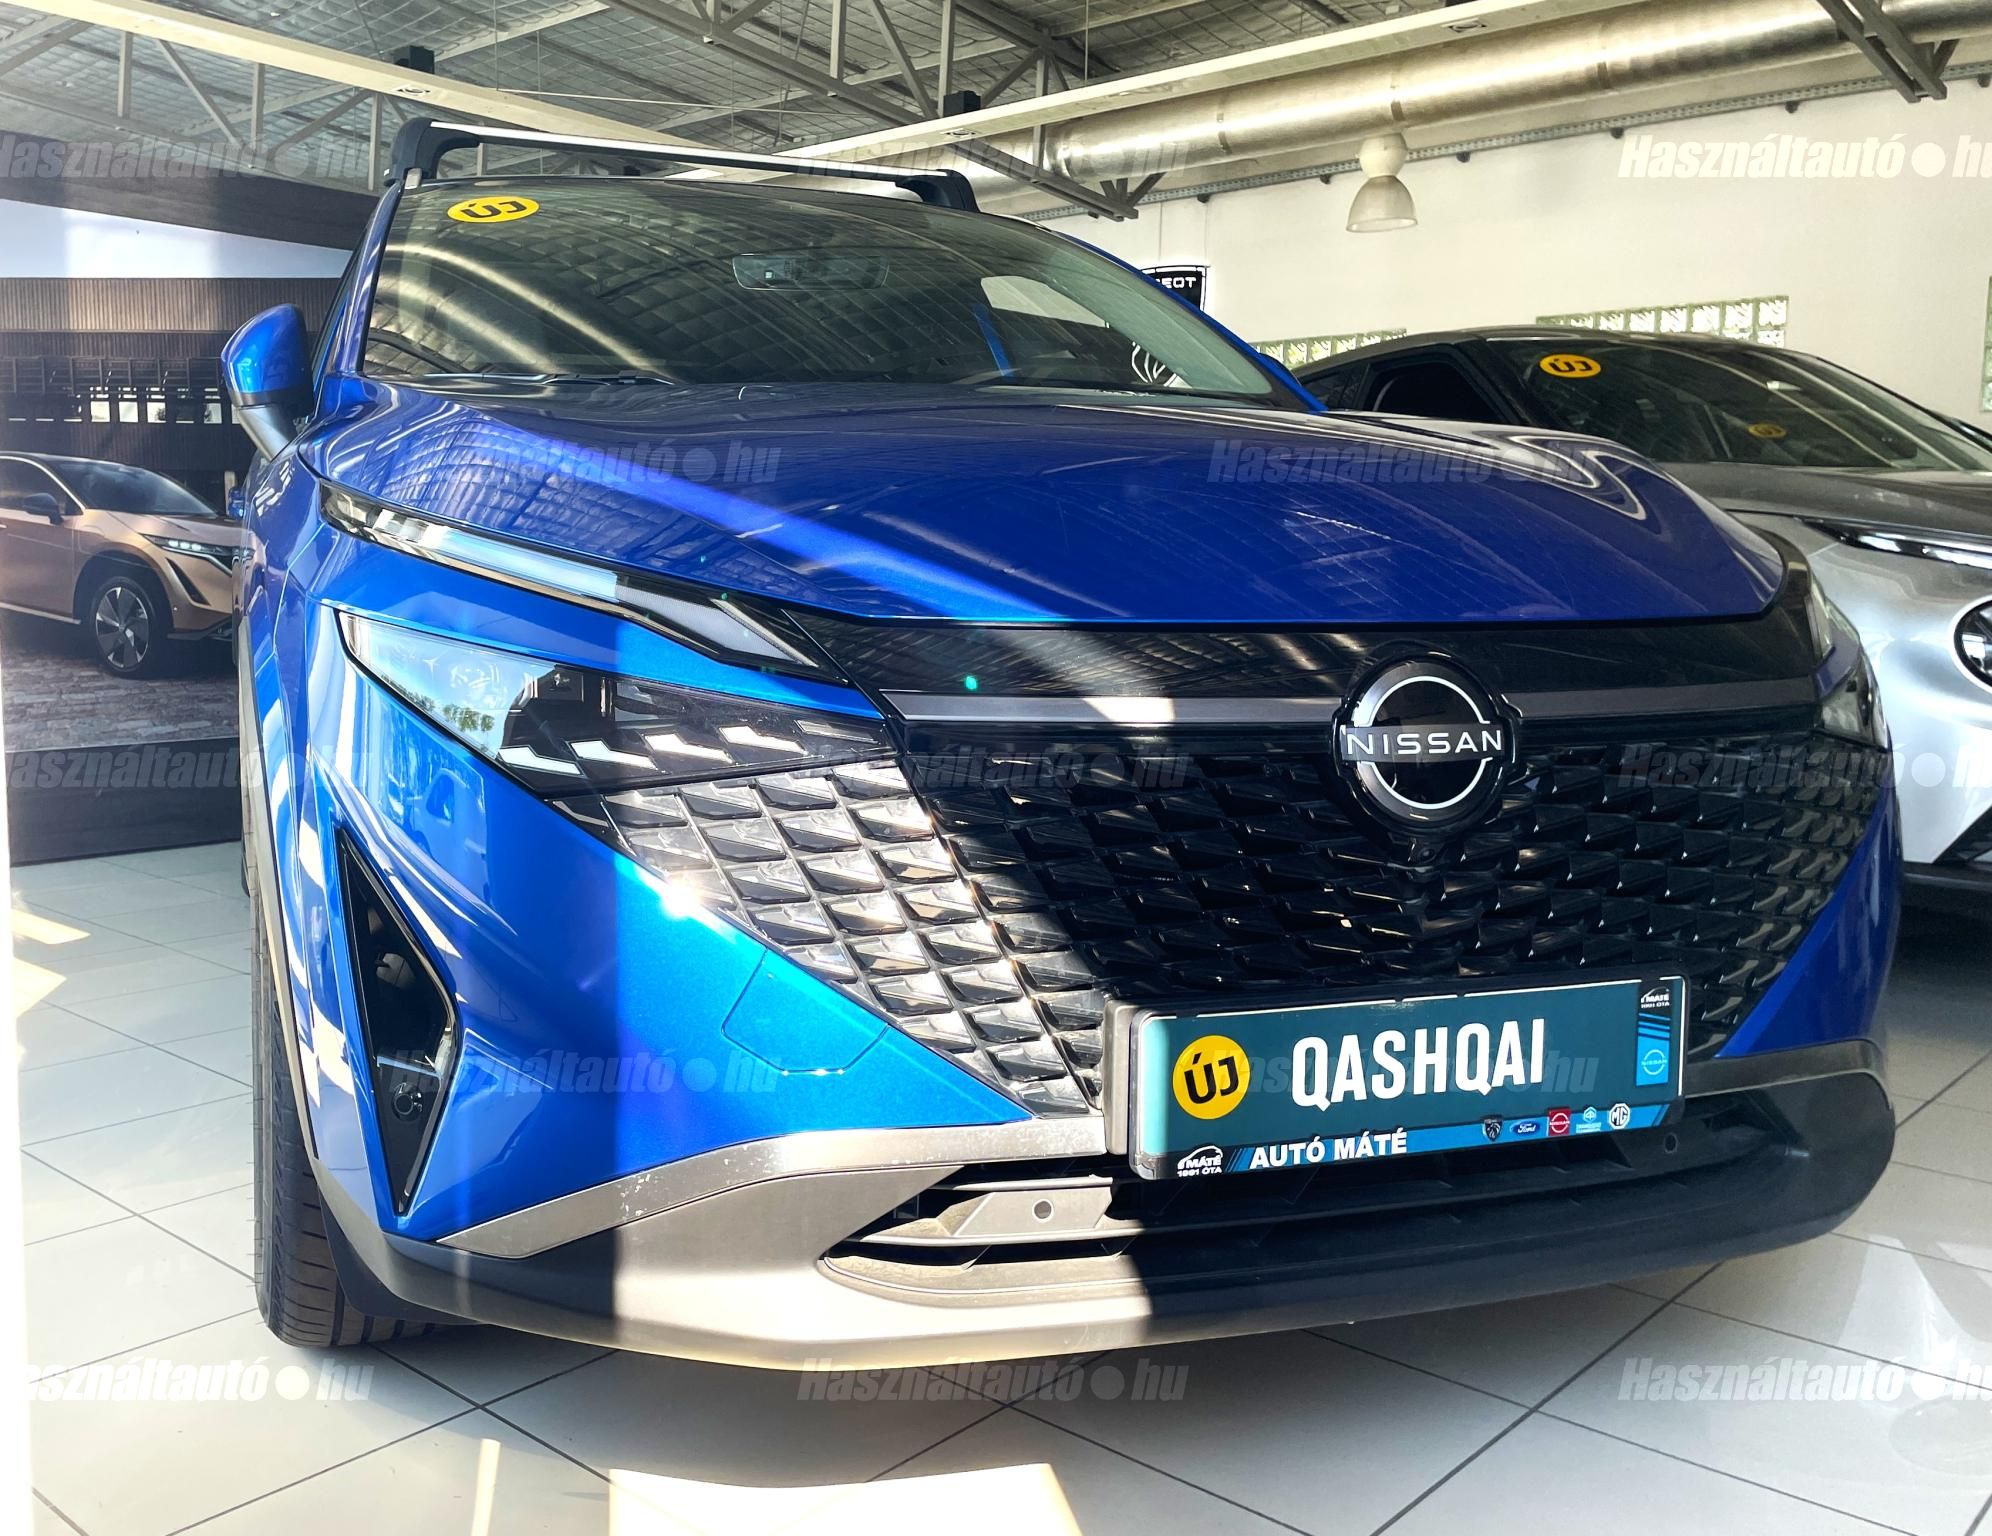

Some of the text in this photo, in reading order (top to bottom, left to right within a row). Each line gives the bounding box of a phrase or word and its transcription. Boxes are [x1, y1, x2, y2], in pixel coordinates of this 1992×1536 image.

[461, 200, 527, 218] ÚJ
[1347, 730, 1501, 754] NISSAN
[1184, 1053, 1238, 1104] ÚJ
[1292, 1018, 1545, 1111] QASHQAI
[1611, 1107, 1628, 1126] MG
[1250, 1128, 1408, 1169] AUTÓ MÁTÉ
